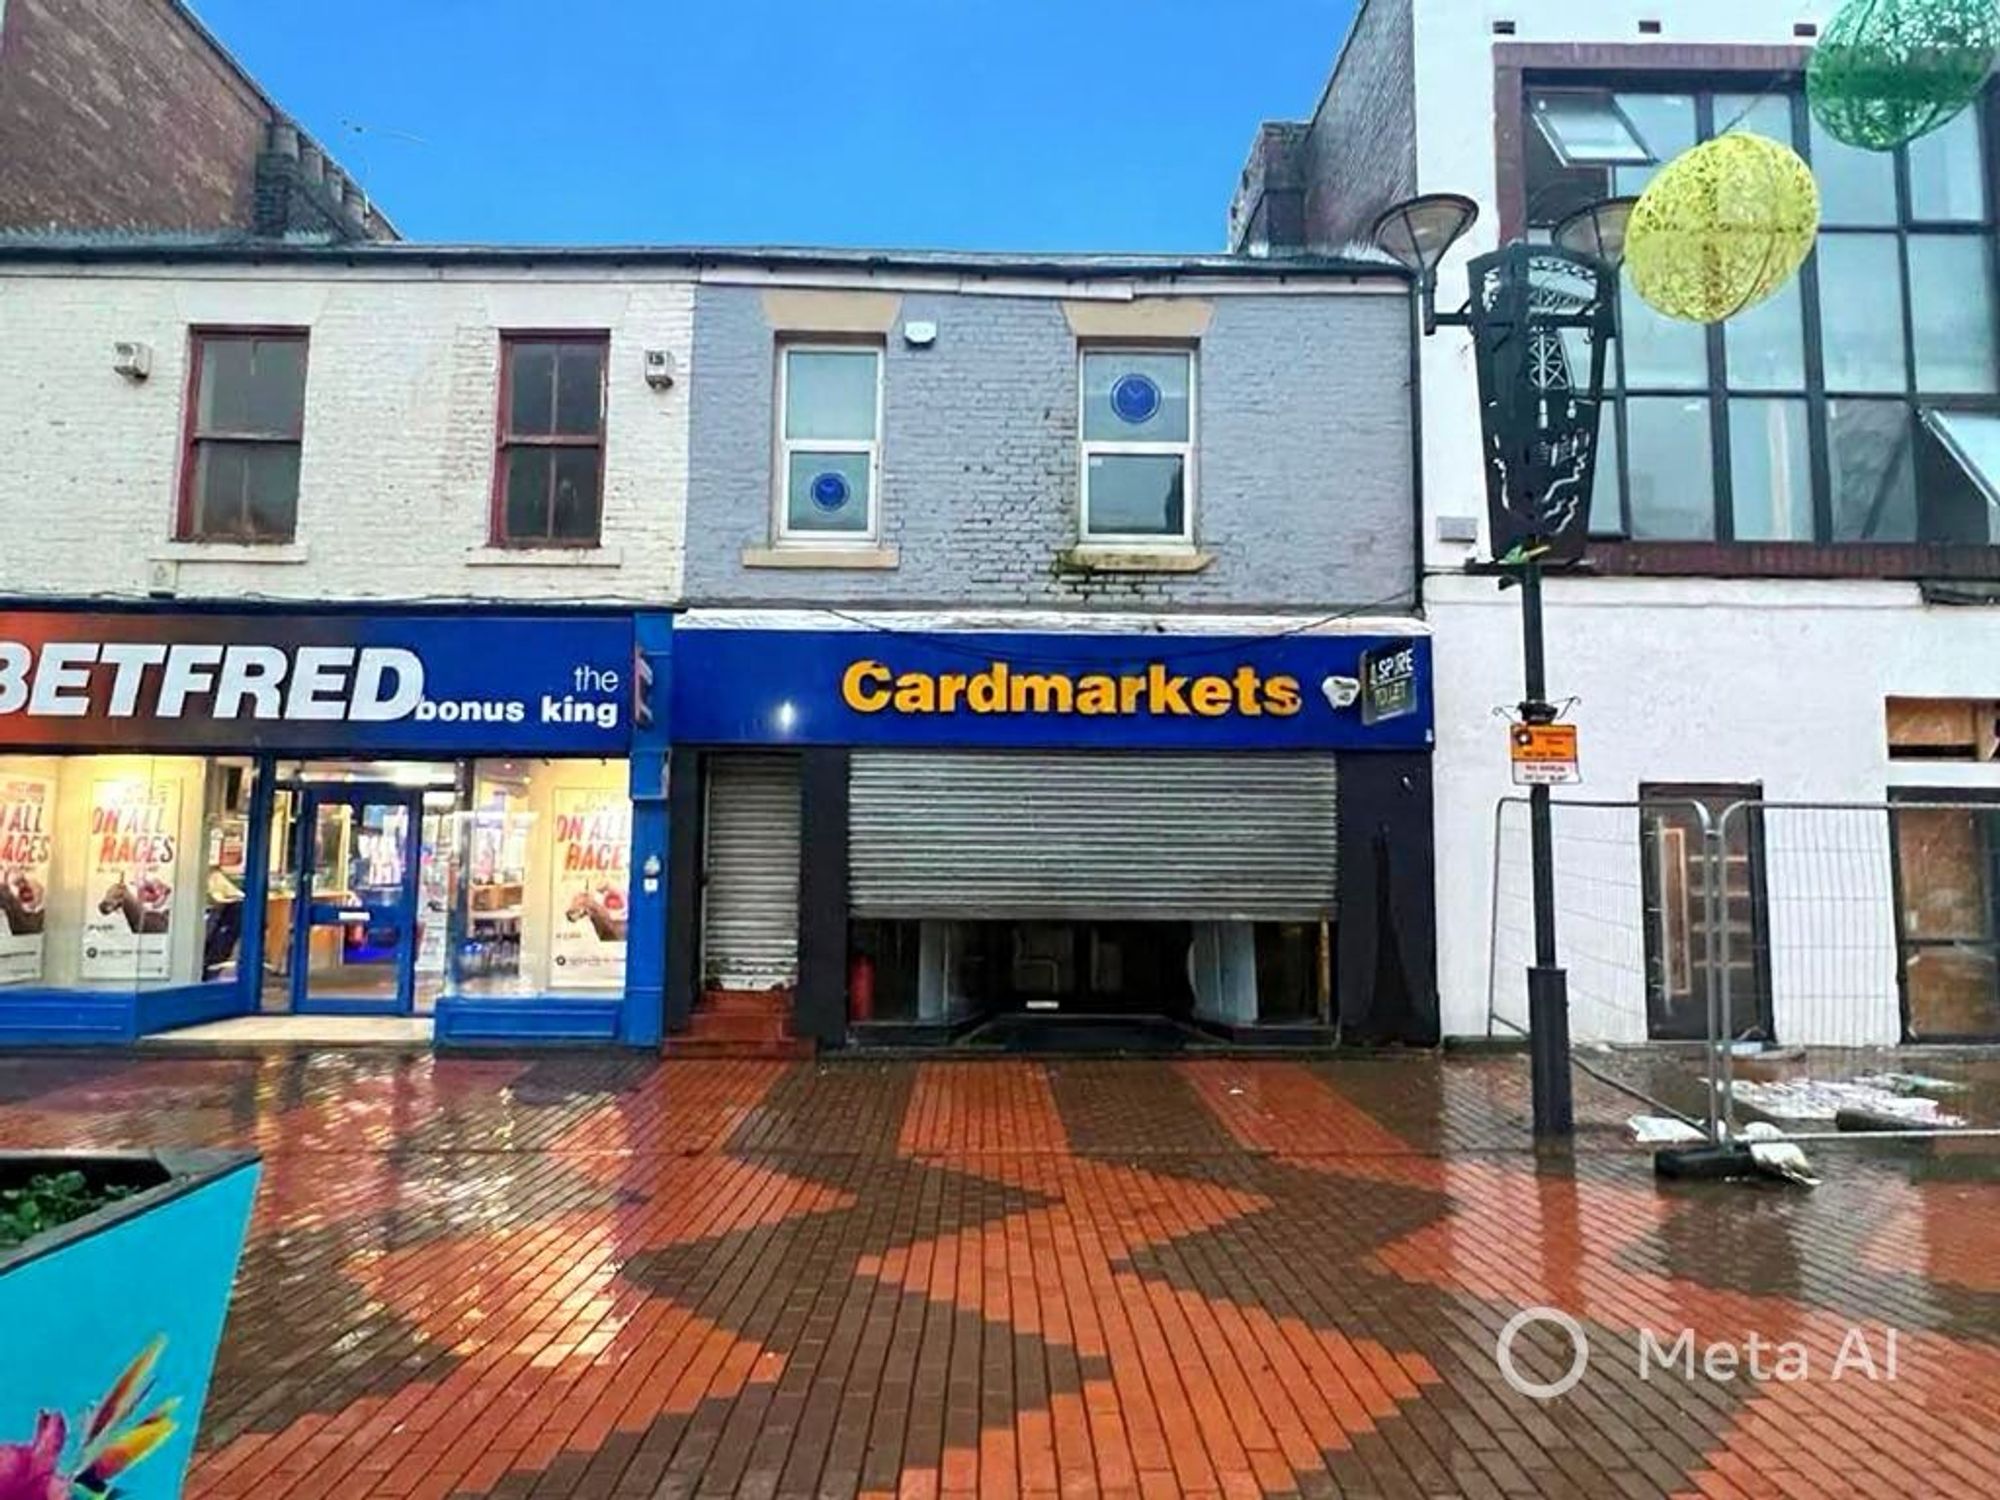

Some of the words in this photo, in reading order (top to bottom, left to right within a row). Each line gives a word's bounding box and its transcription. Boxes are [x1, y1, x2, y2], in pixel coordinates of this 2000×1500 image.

[574, 665, 619, 692] the
[842, 660, 1301, 716] Cardmarkets
[414, 694, 525, 721] bonus
[541, 695, 618, 728] king
[0, 834, 50, 863] ACES
[100, 834, 175, 864] RACES
[564, 842, 630, 871] RACE
